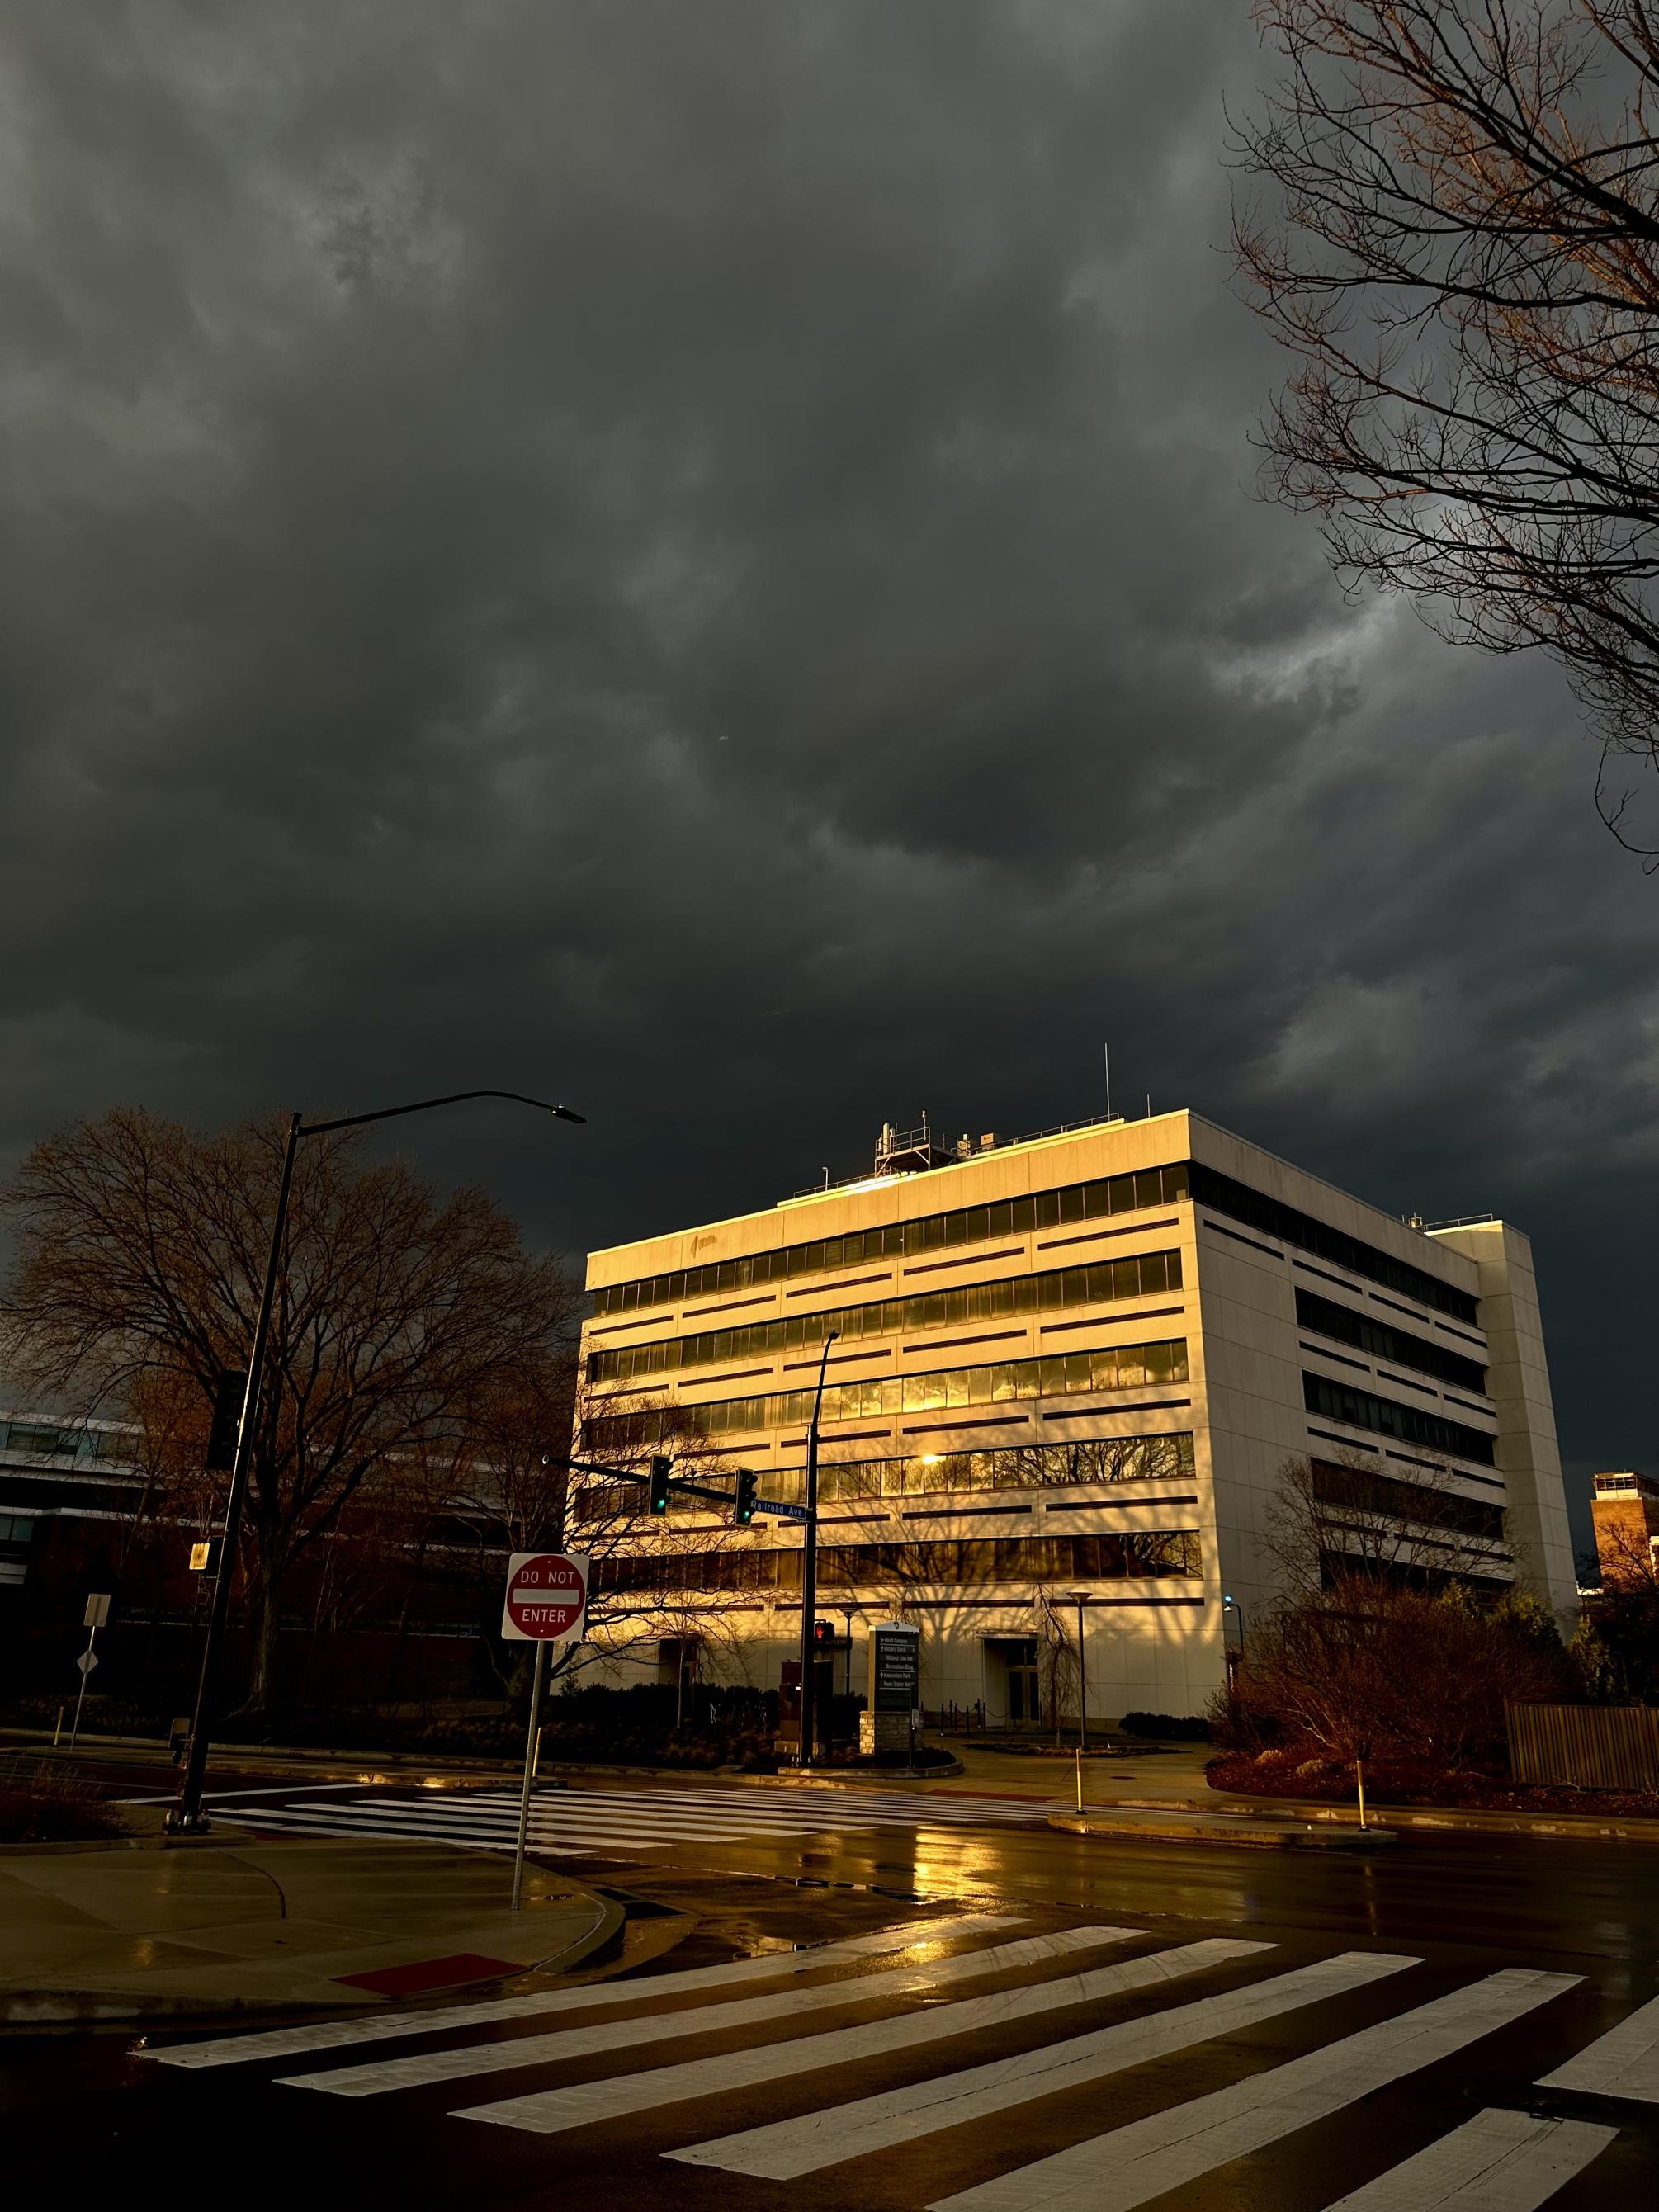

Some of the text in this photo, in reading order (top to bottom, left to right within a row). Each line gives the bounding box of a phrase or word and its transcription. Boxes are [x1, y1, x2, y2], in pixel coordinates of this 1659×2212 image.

[750, 1500, 802, 1517] Railroad Ave
[520, 1571, 575, 1585] DO NOT
[522, 1609, 566, 1624] ENTER
